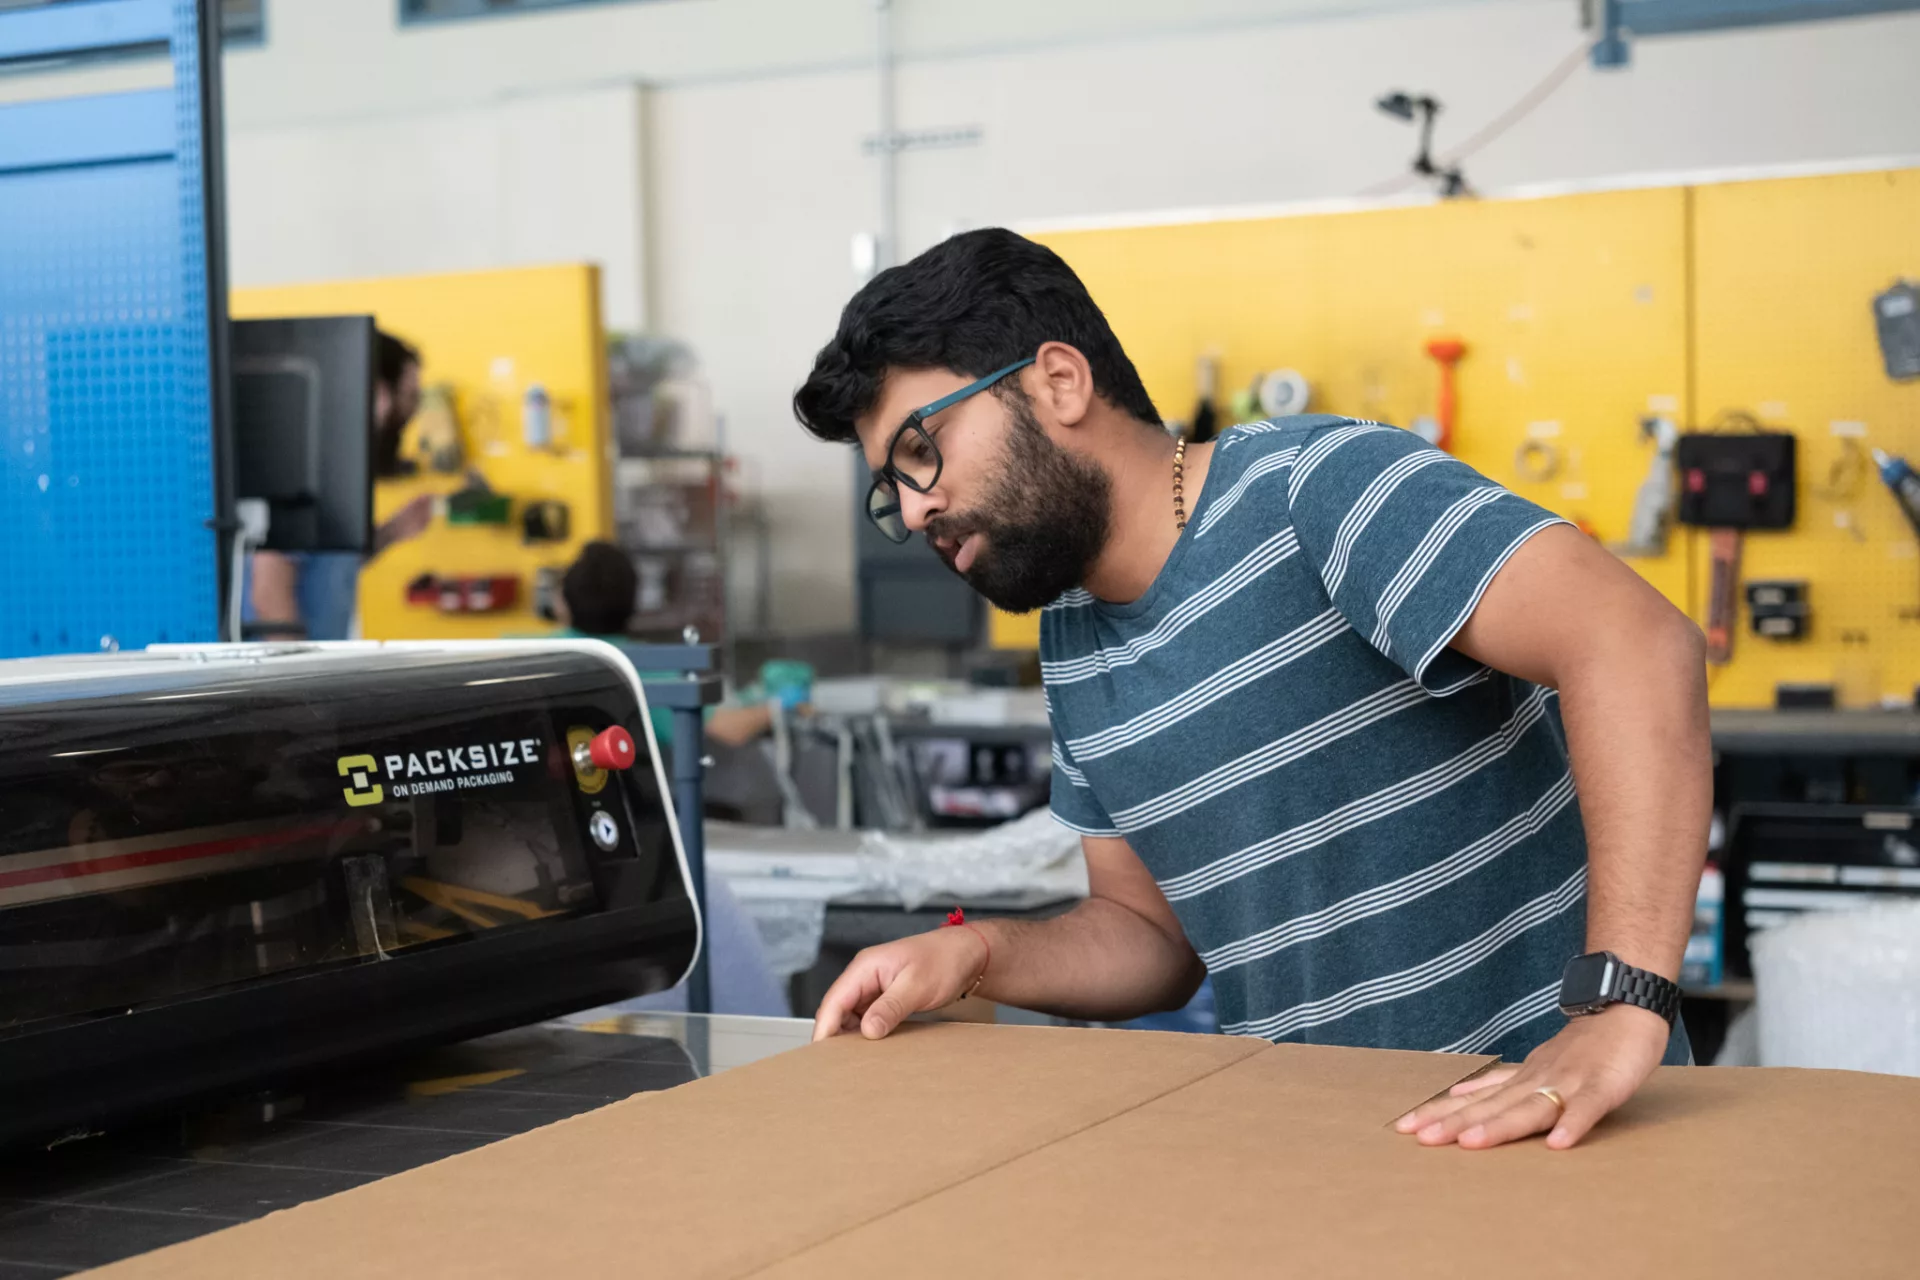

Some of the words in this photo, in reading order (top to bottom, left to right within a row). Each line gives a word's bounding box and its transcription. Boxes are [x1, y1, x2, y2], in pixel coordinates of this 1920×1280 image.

[384, 739, 540, 780] PACKSIZE
[393, 784, 409, 797] ON
[411, 778, 455, 795] DEMAND
[456, 770, 515, 789] PACKAGING
